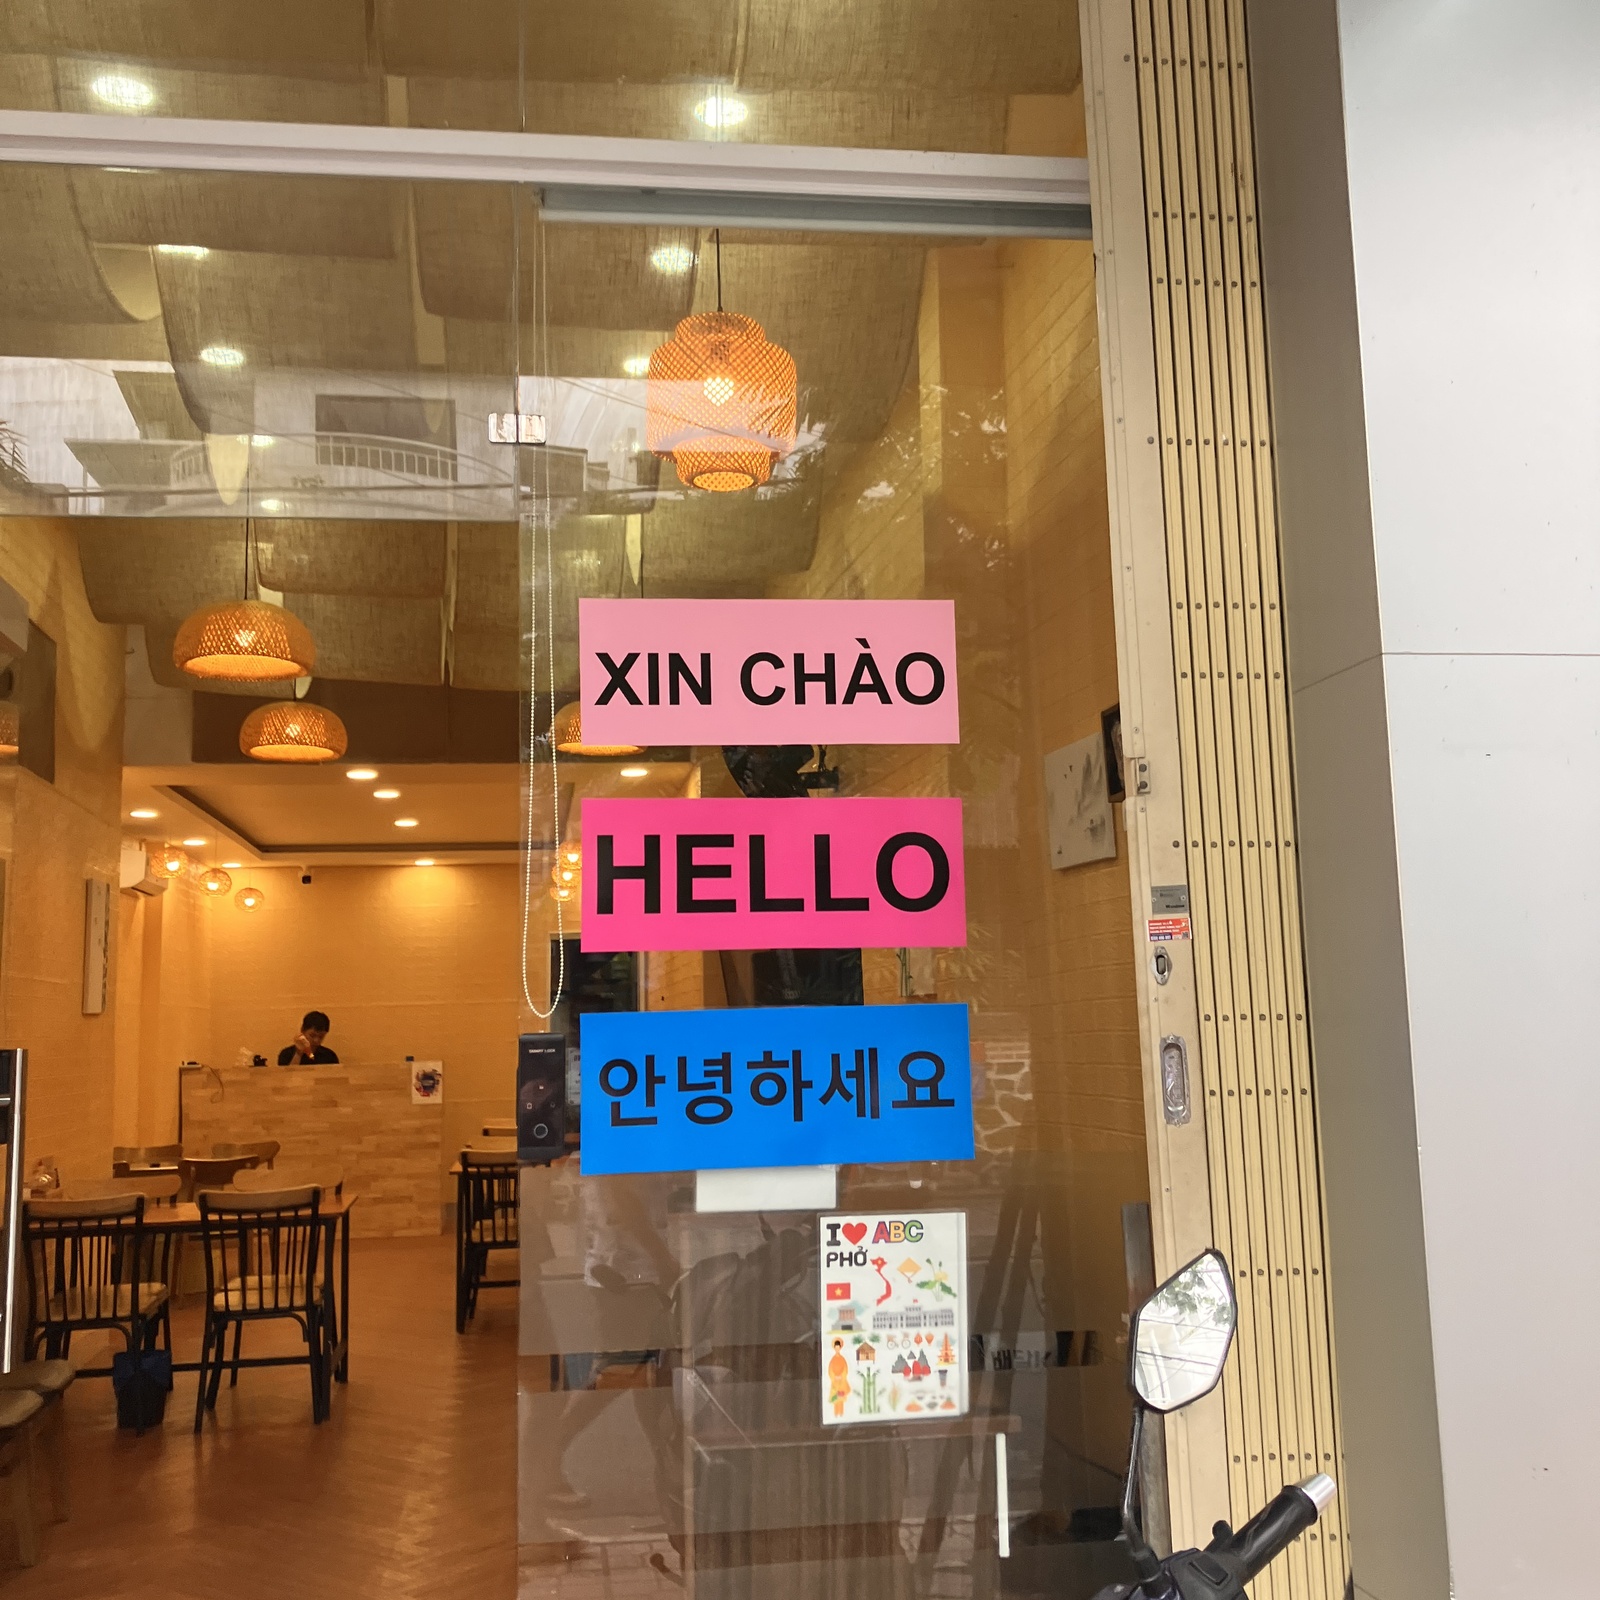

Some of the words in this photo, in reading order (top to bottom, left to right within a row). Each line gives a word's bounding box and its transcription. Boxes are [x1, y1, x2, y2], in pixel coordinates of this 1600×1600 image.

[594, 652, 712, 706] XIN
[740, 637, 945, 706] CHÀO
[596, 831, 950, 915] HELLO
[599, 1047, 955, 1127] 안녕하세요
[826, 1222, 841, 1247] I
[872, 1219, 924, 1245] ABC
[826, 1246, 868, 1268] PHỞ
